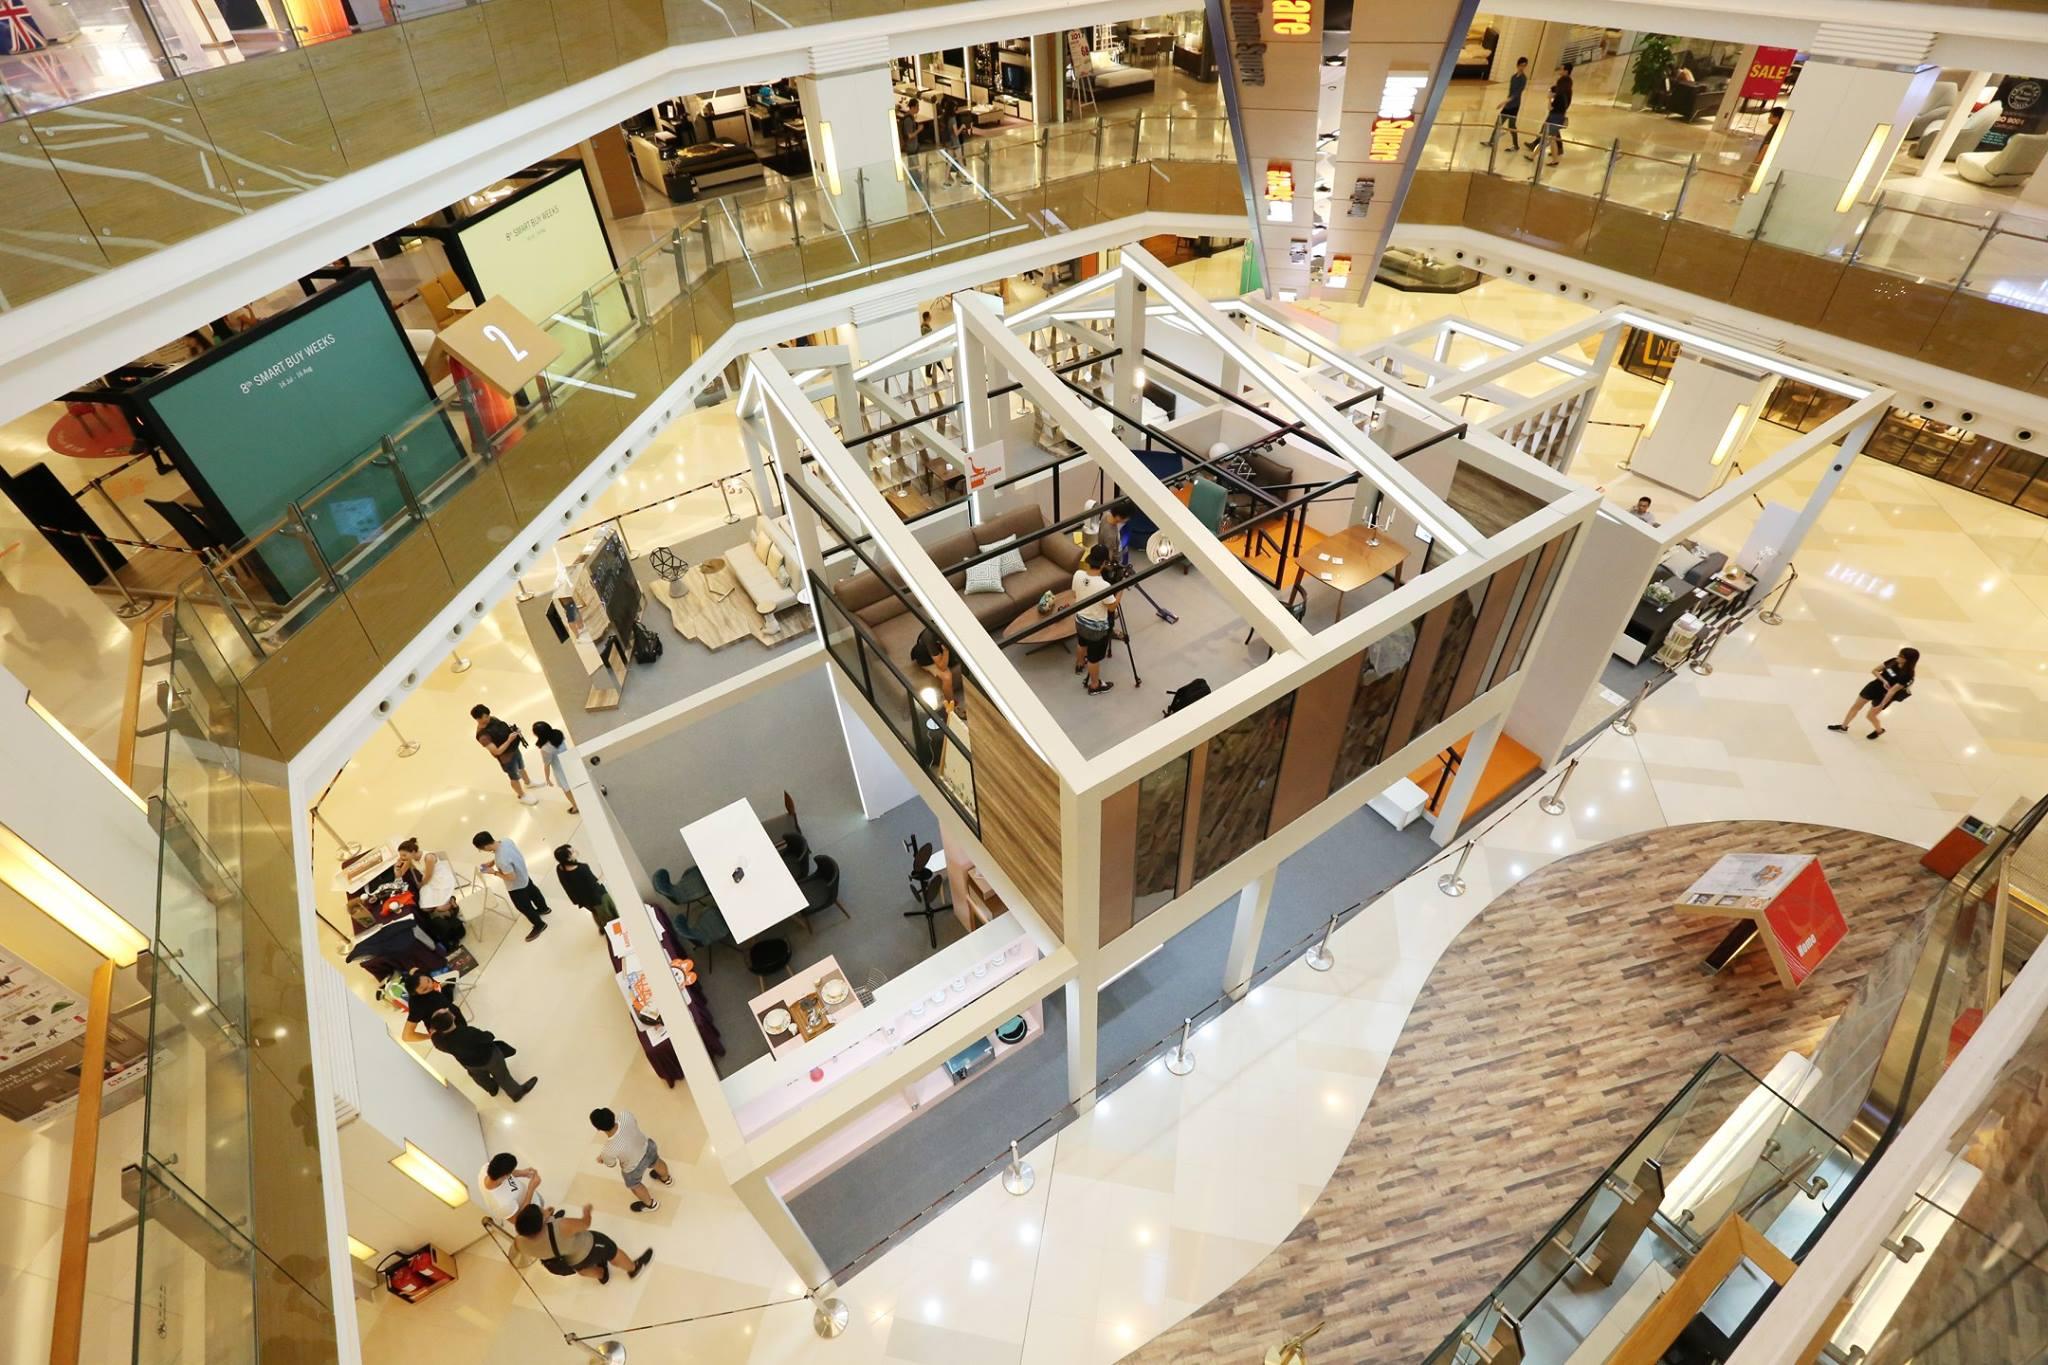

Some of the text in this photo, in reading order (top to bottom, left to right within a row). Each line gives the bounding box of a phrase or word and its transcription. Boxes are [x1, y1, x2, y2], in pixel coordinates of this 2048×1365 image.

[1750, 64, 1788, 80] SALE
[253, 360, 287, 386] SMART
[284, 350, 305, 369] BUY
[303, 333, 336, 357] WEEKS
[483, 325, 528, 362] 2
